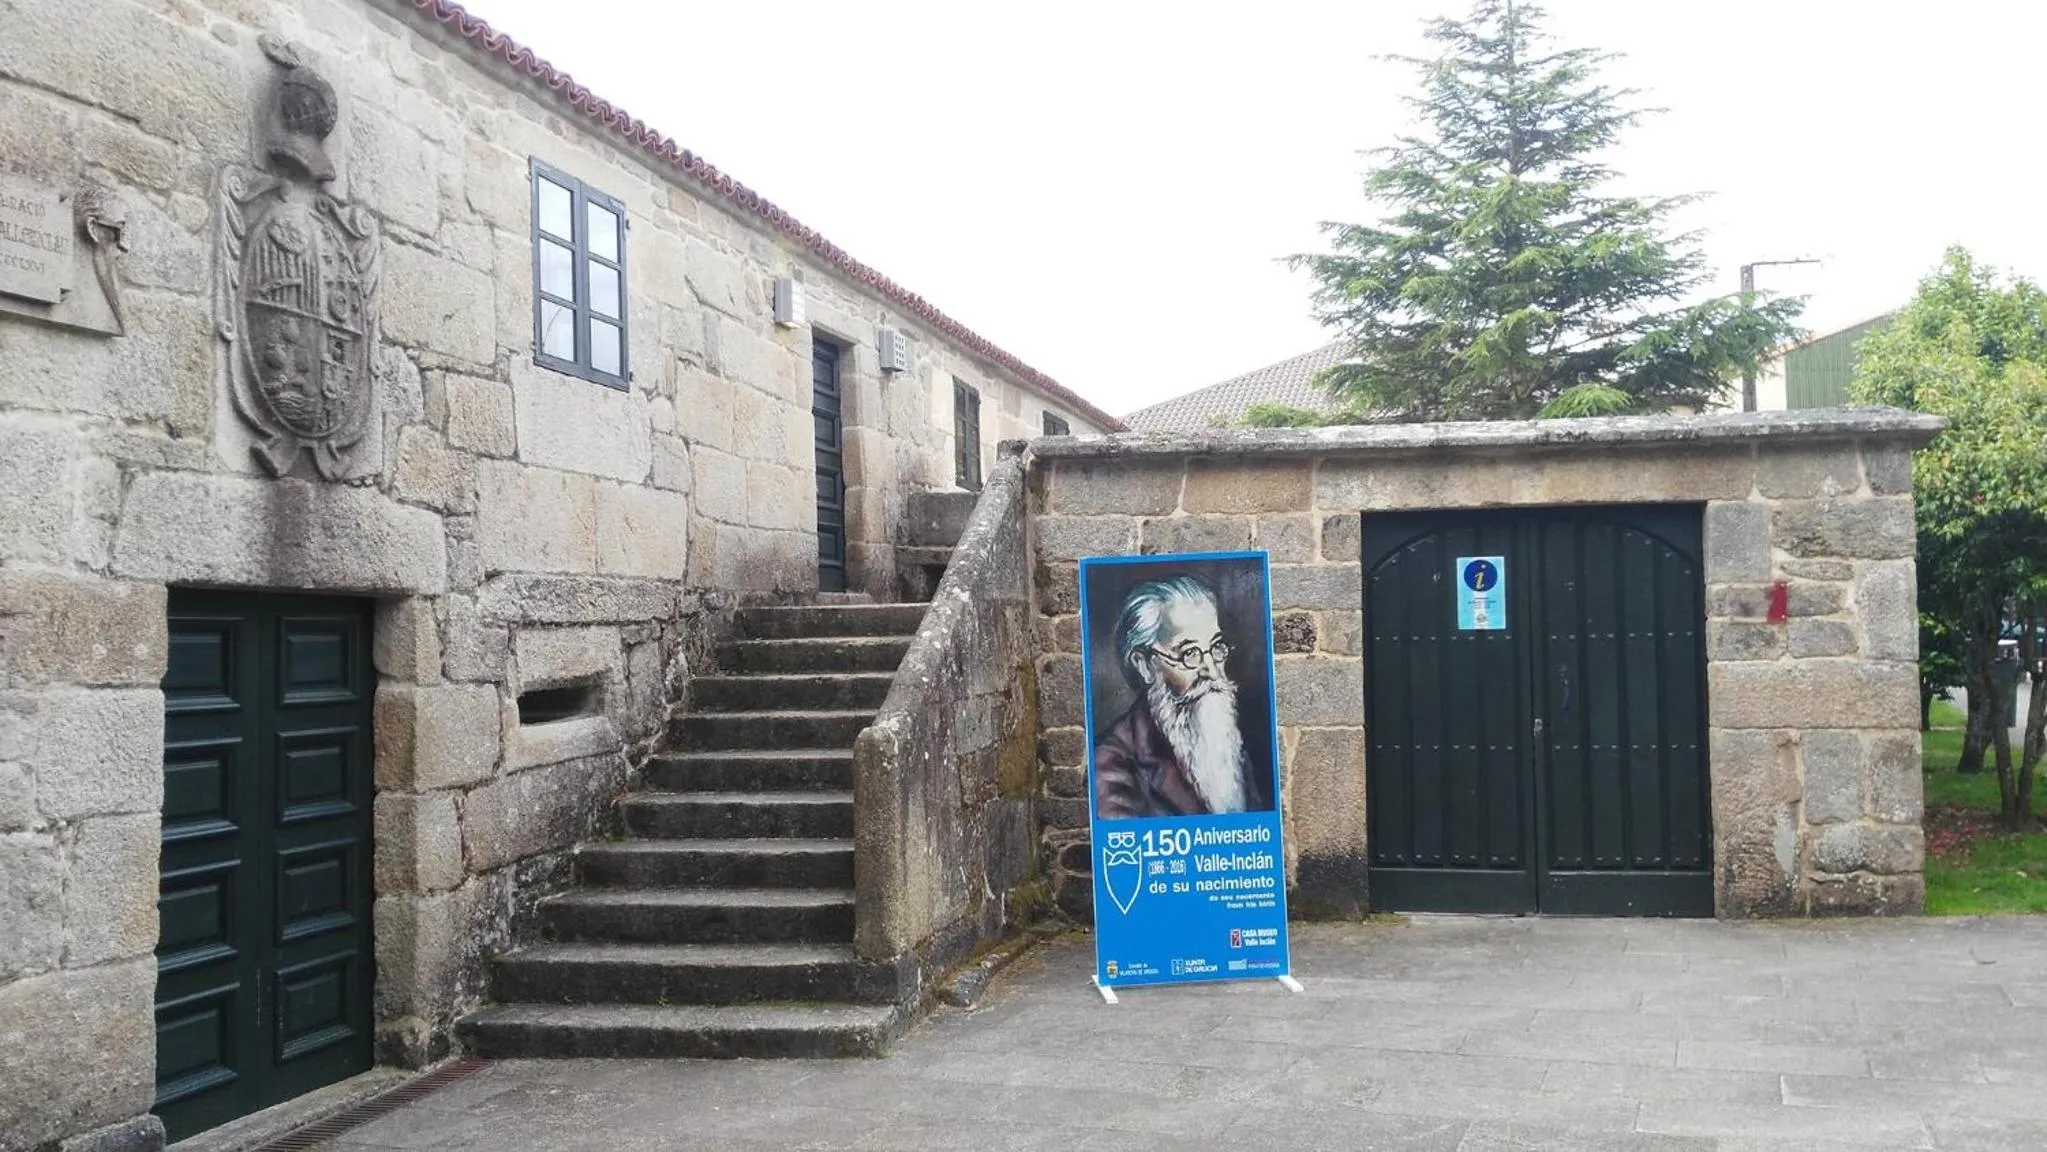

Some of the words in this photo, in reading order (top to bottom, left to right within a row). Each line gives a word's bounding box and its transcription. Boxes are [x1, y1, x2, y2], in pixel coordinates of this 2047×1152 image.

[1142, 828, 1191, 856] 150
[1193, 824, 1271, 845] Aniversario
[1194, 850, 1273, 872] Valle-Inclán
[1149, 880, 1167, 894] de
[1172, 881, 1189, 893] su
[1196, 875, 1275, 891] nacimiento
[1242, 929, 1257, 937] CASA
[1257, 928, 1278, 936] MUSEO
